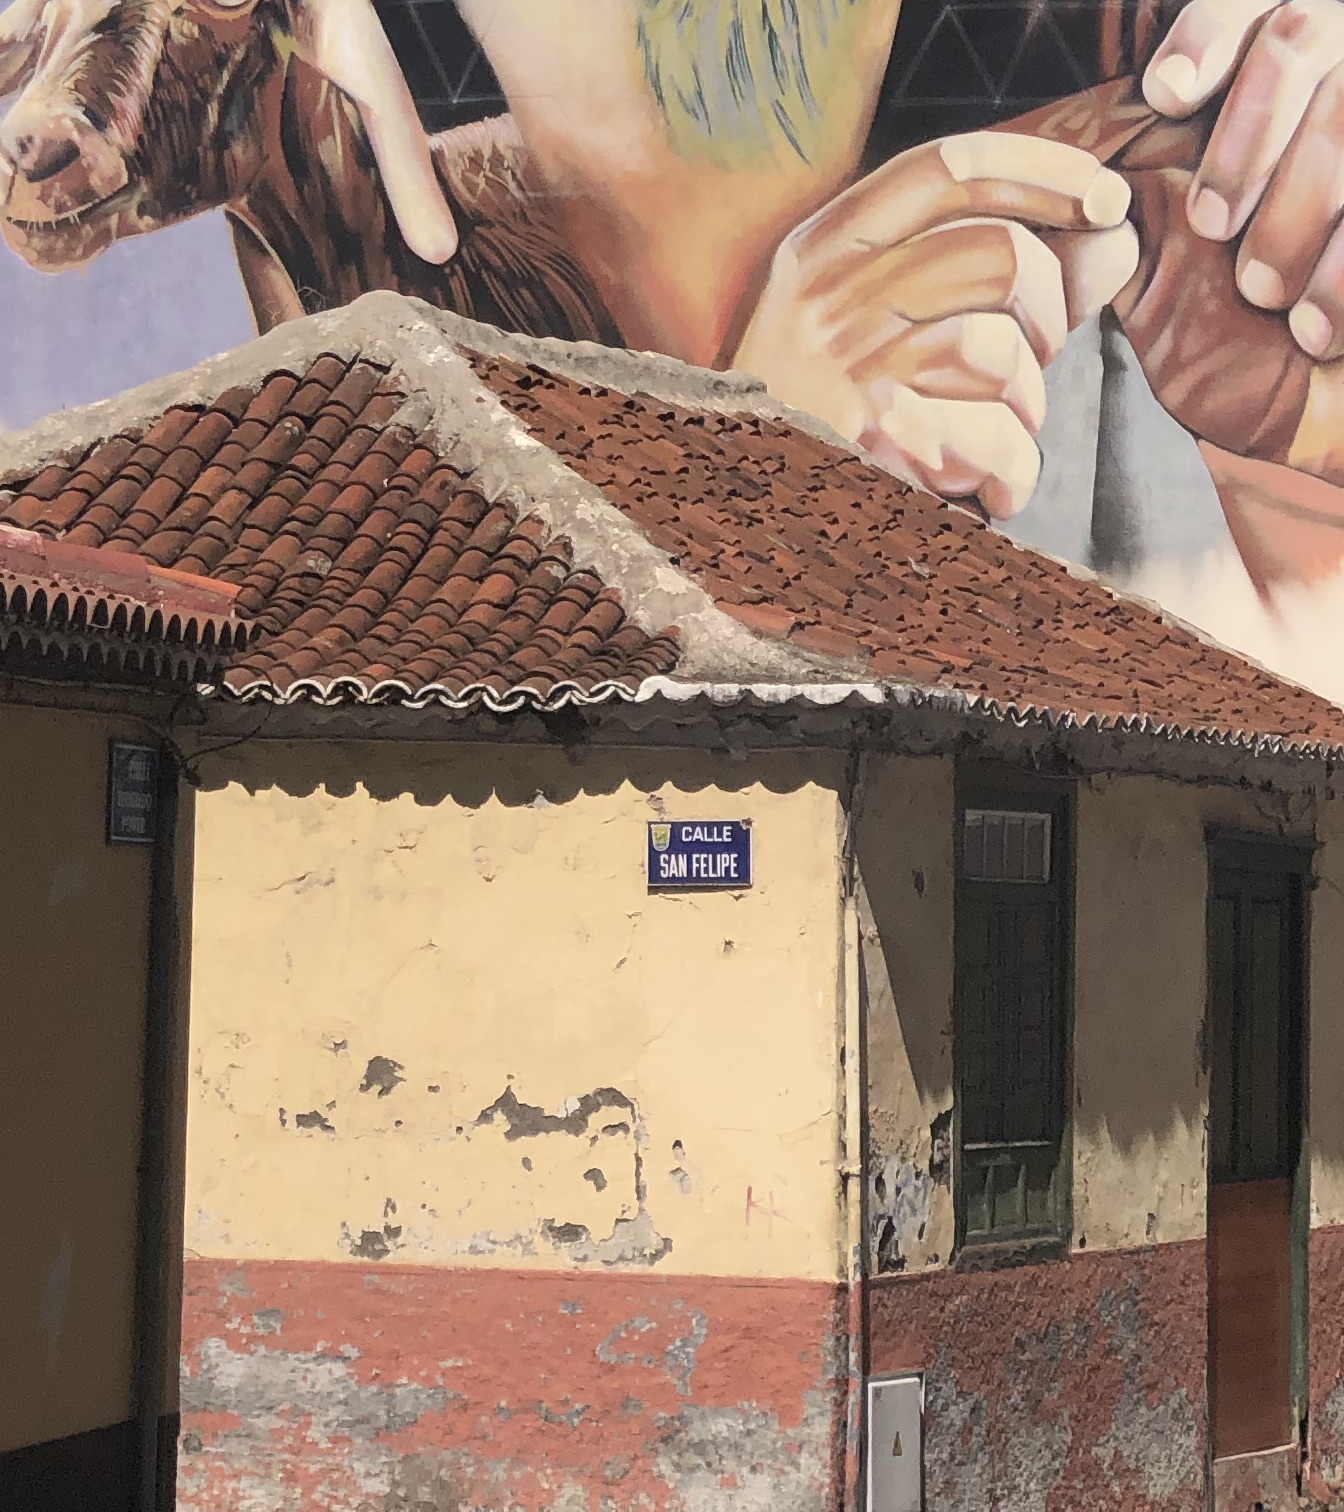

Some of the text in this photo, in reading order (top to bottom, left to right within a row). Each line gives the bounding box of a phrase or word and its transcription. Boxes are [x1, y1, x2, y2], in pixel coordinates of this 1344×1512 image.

[681, 825, 733, 842] CALLE
[659, 853, 739, 879] SAN FELIPE
